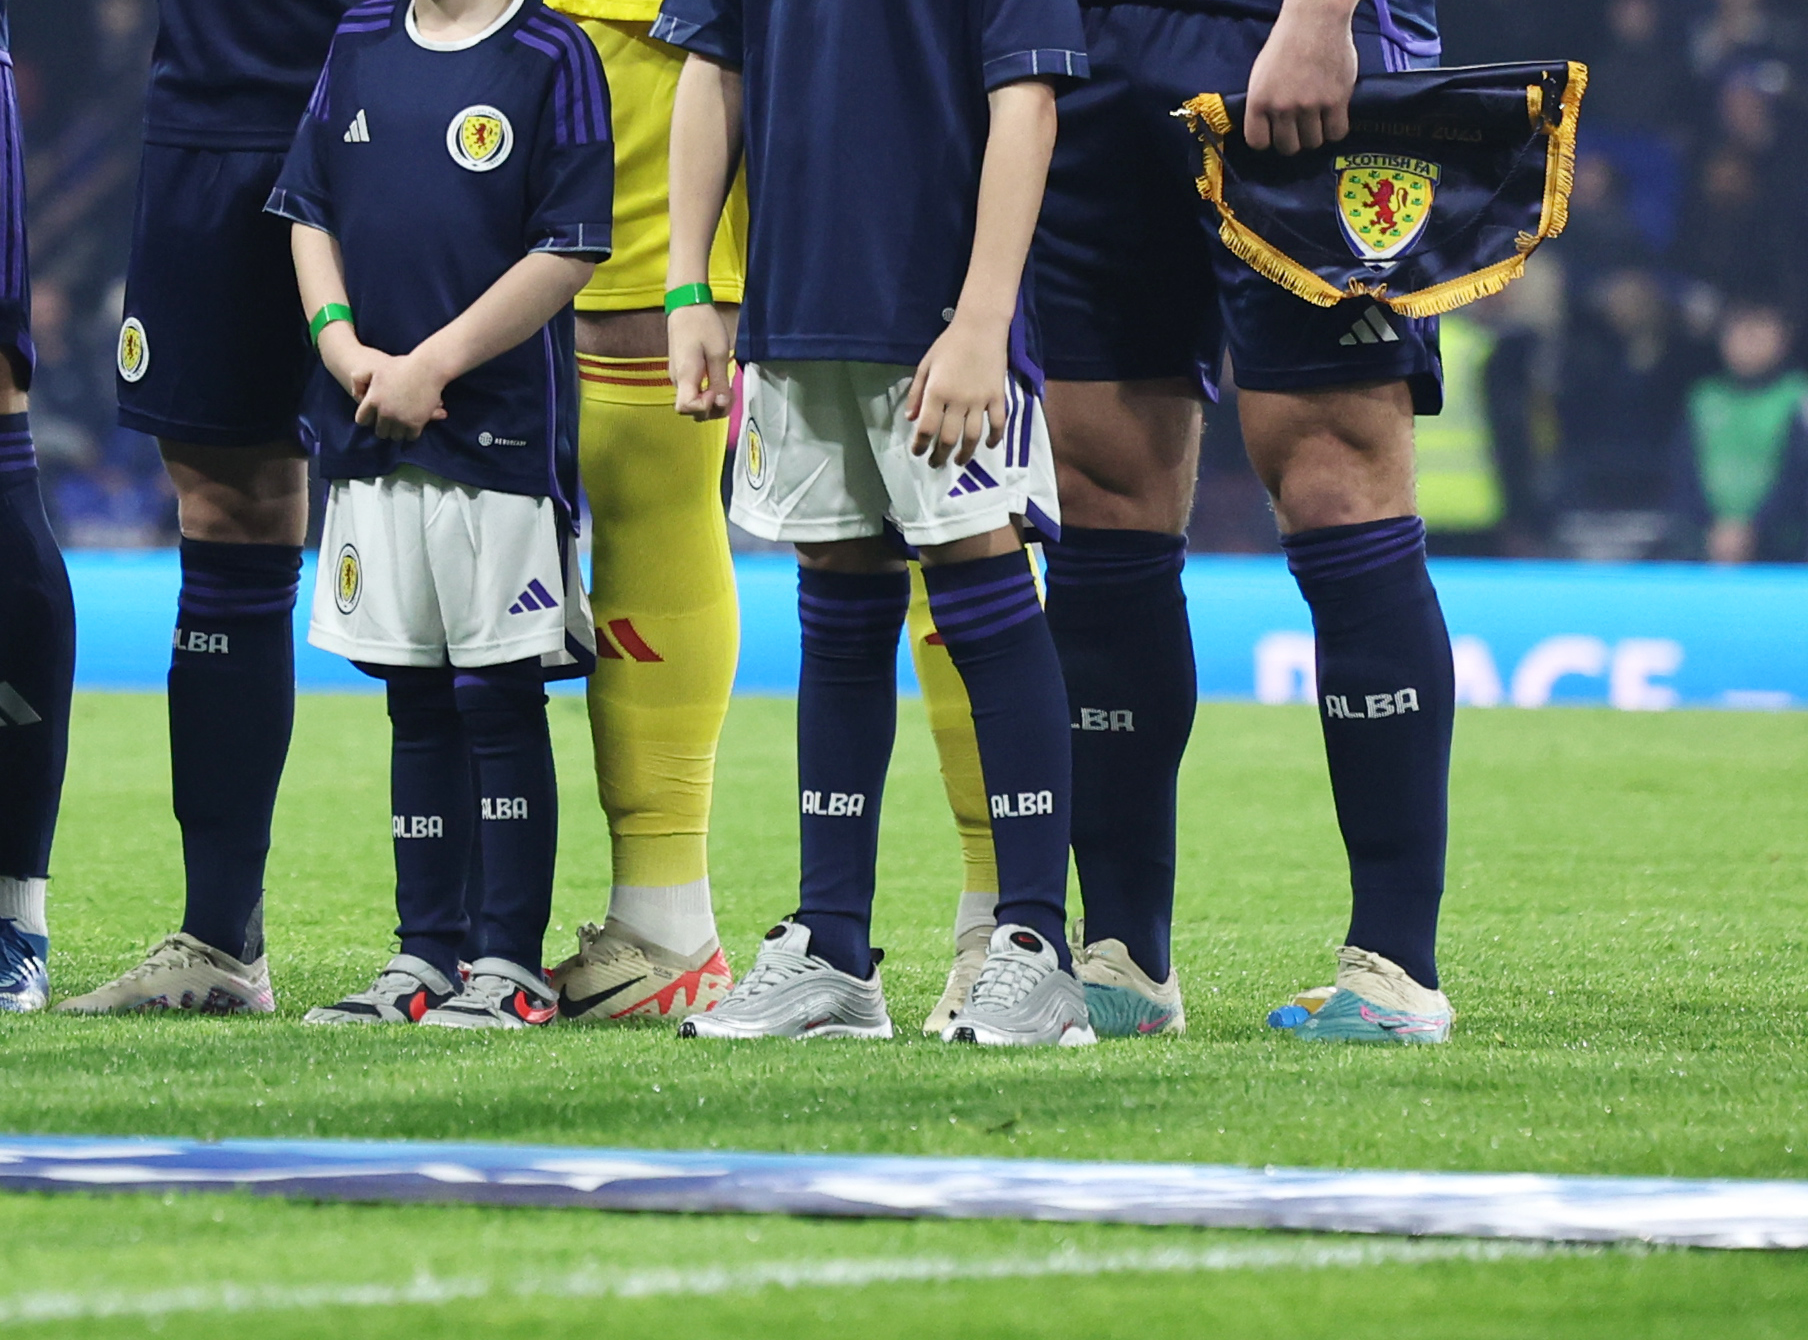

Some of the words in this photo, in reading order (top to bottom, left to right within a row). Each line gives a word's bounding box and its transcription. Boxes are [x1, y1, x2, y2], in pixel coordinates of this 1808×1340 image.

[1344, 154, 1411, 171] SCOTTISH
[1414, 161, 1432, 176] FA
[1325, 687, 1419, 719] ALBA
[802, 790, 865, 817] ALBA
[991, 789, 1053, 819] ALBA
[392, 815, 444, 839] ALBA
